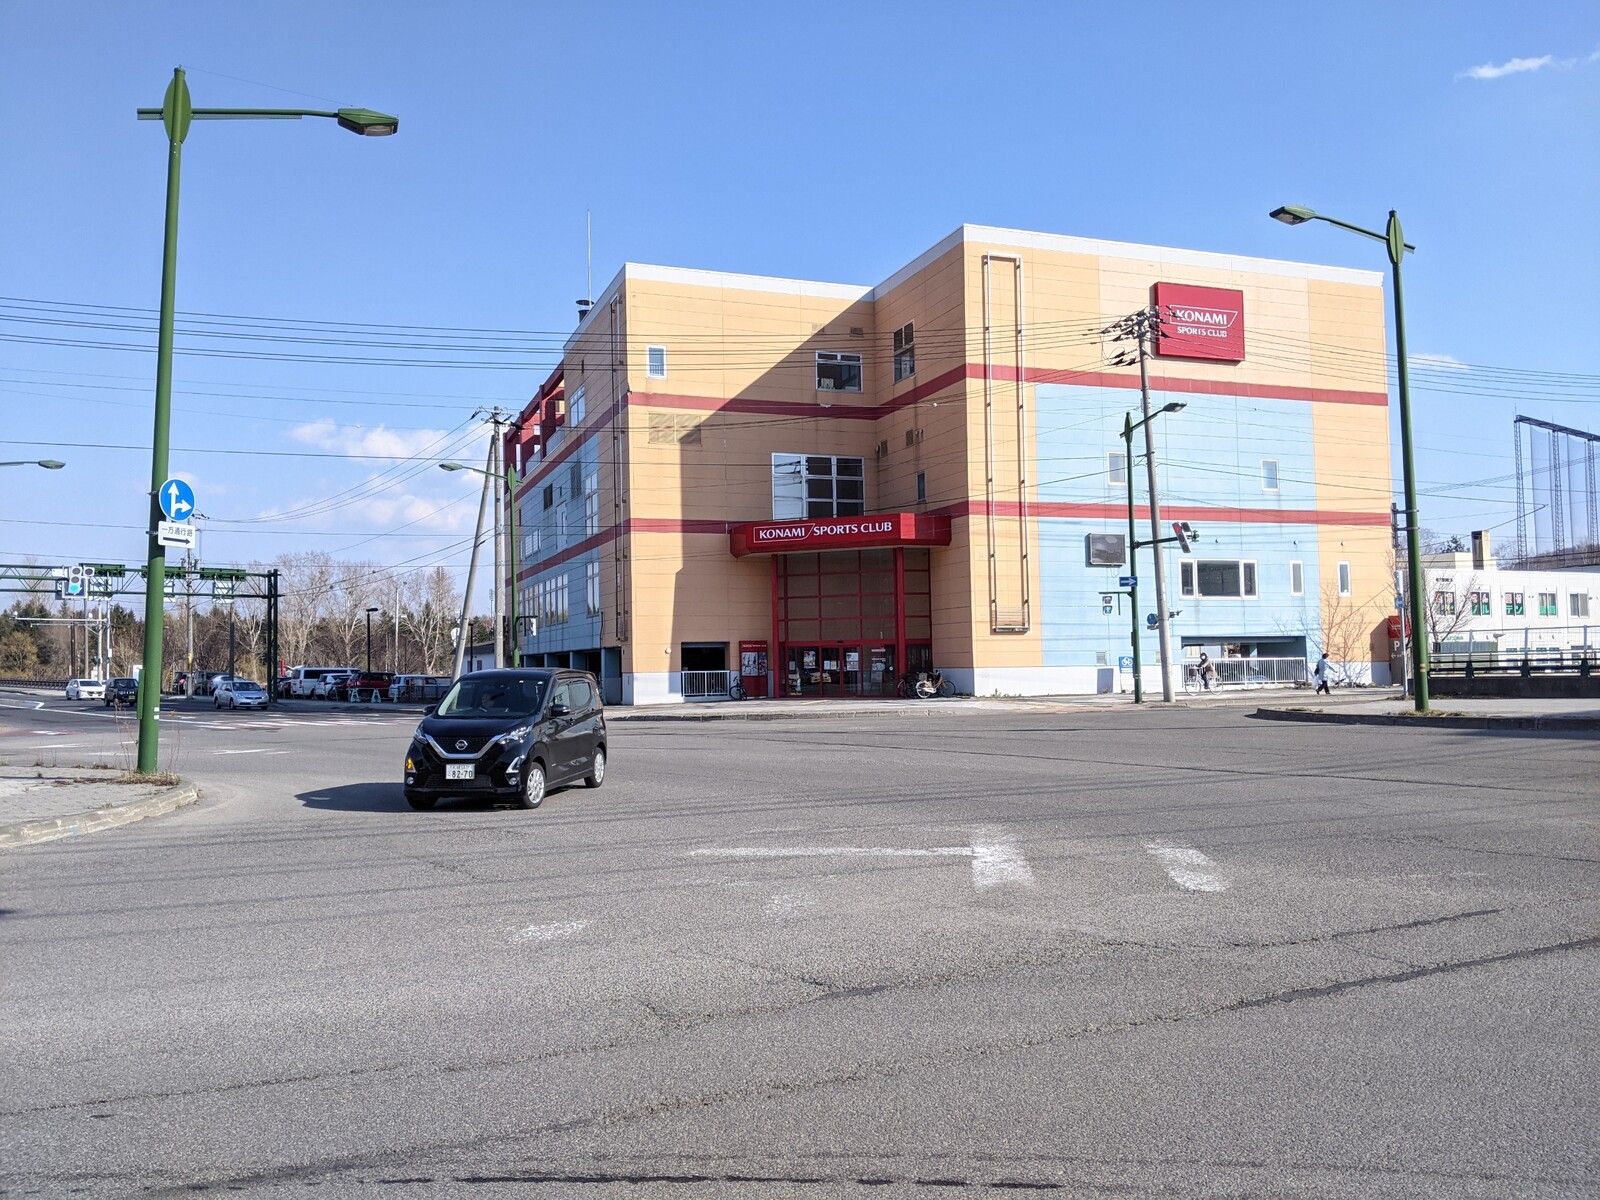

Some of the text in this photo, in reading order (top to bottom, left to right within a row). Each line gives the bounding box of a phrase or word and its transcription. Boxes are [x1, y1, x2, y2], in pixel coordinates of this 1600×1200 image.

[1175, 309, 1228, 325] KONAMI
[1177, 326, 1228, 338] SPORTS CLUB
[161, 526, 194, 537] 一方通行路
[759, 521, 892, 539] KONAMI SPORTS CLUB
[1393, 640, 1400, 651] P
[451, 770, 473, 779] 82-70
